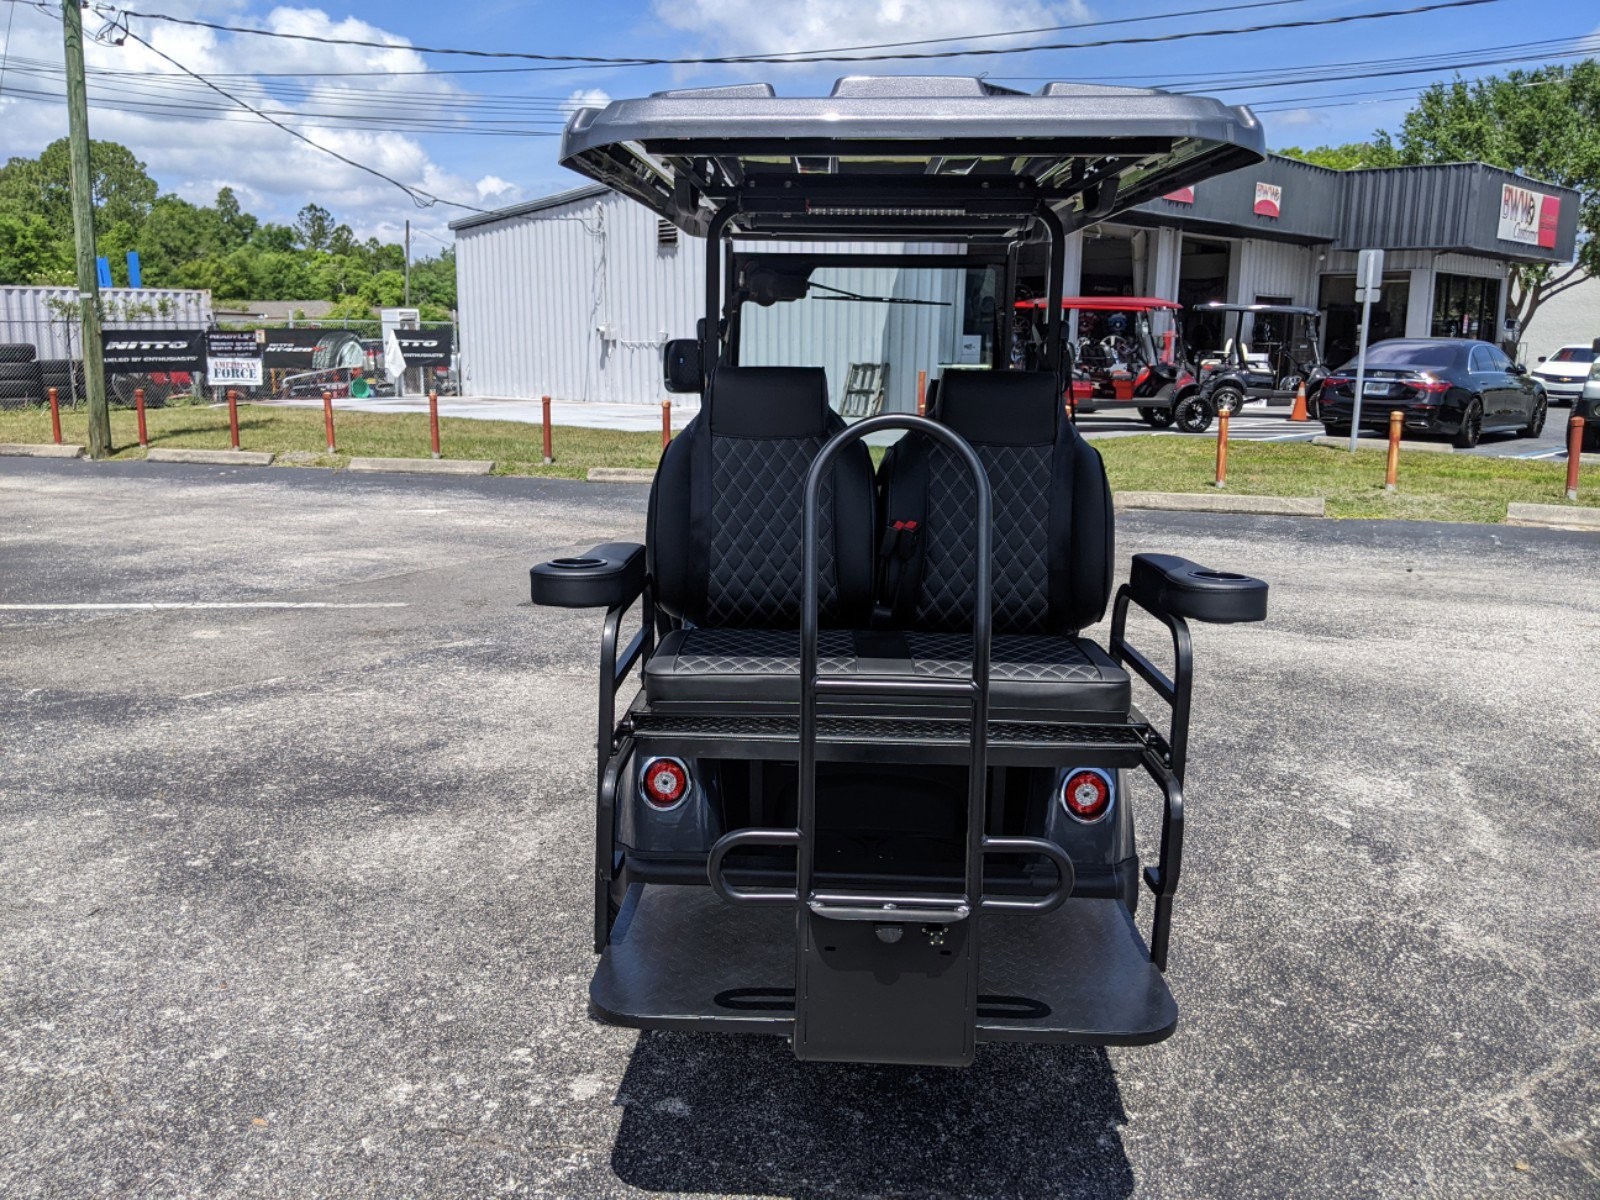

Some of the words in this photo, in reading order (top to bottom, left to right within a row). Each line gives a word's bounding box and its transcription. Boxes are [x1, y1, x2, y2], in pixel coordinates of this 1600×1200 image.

[105, 340, 189, 350] NITTO
[400, 339, 439, 348] TTO
[214, 361, 257, 369] AMERICAN
[214, 368, 258, 379] FORCE
